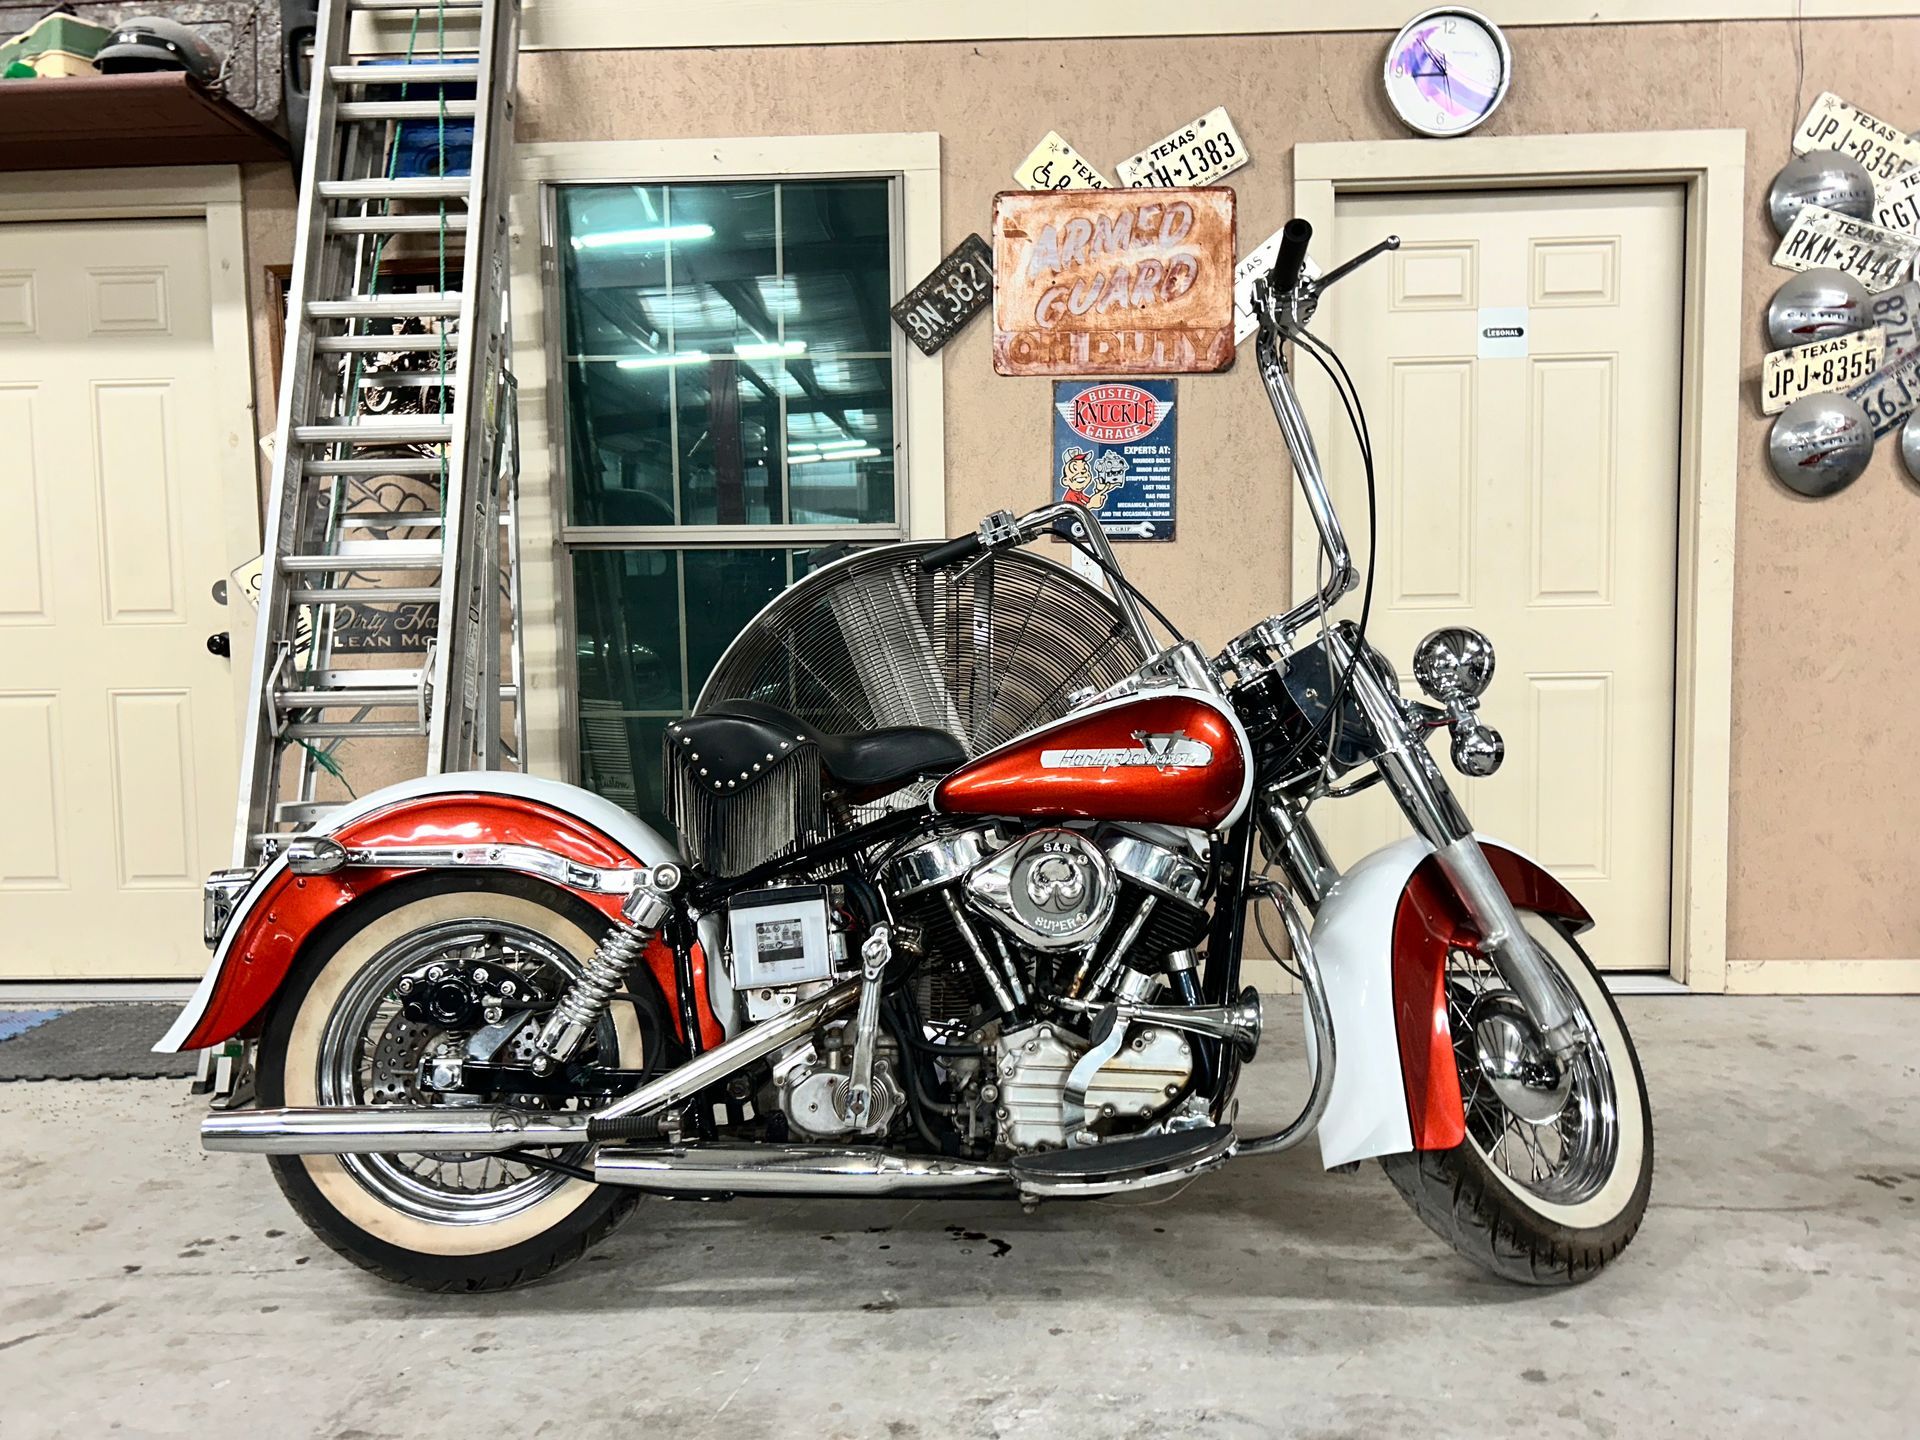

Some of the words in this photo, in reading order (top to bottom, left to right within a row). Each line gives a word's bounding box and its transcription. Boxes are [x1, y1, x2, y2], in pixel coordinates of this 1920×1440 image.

[1444, 21, 1456, 34] 12
[1395, 65, 1404, 79] 9
[1436, 112, 1445, 125] 6
[1852, 110, 1896, 142] TEXAS
[1151, 130, 1195, 161] TEXAS
[1072, 159, 1108, 189] TEXA
[1028, 201, 1195, 278] ARMED
[1836, 220, 1885, 243] TEXAS
[1236, 256, 1262, 280] XAS
[1034, 253, 1199, 329] GUARD
[1089, 329, 1220, 363] DUTY
[1801, 338, 1848, 359] TEXAS
[1088, 388, 1141, 401] BUSTED
[1074, 398, 1154, 428] KNUCKLE
[1085, 424, 1144, 440] GARAGE
[1124, 446, 1157, 455] EXPERTS
[1158, 446, 1171, 455] AT:
[334, 604, 388, 637] Dirty
[393, 604, 439, 630] Ha
[334, 635, 391, 647] LEAN
[1034, 916, 1076, 932] SUPER
